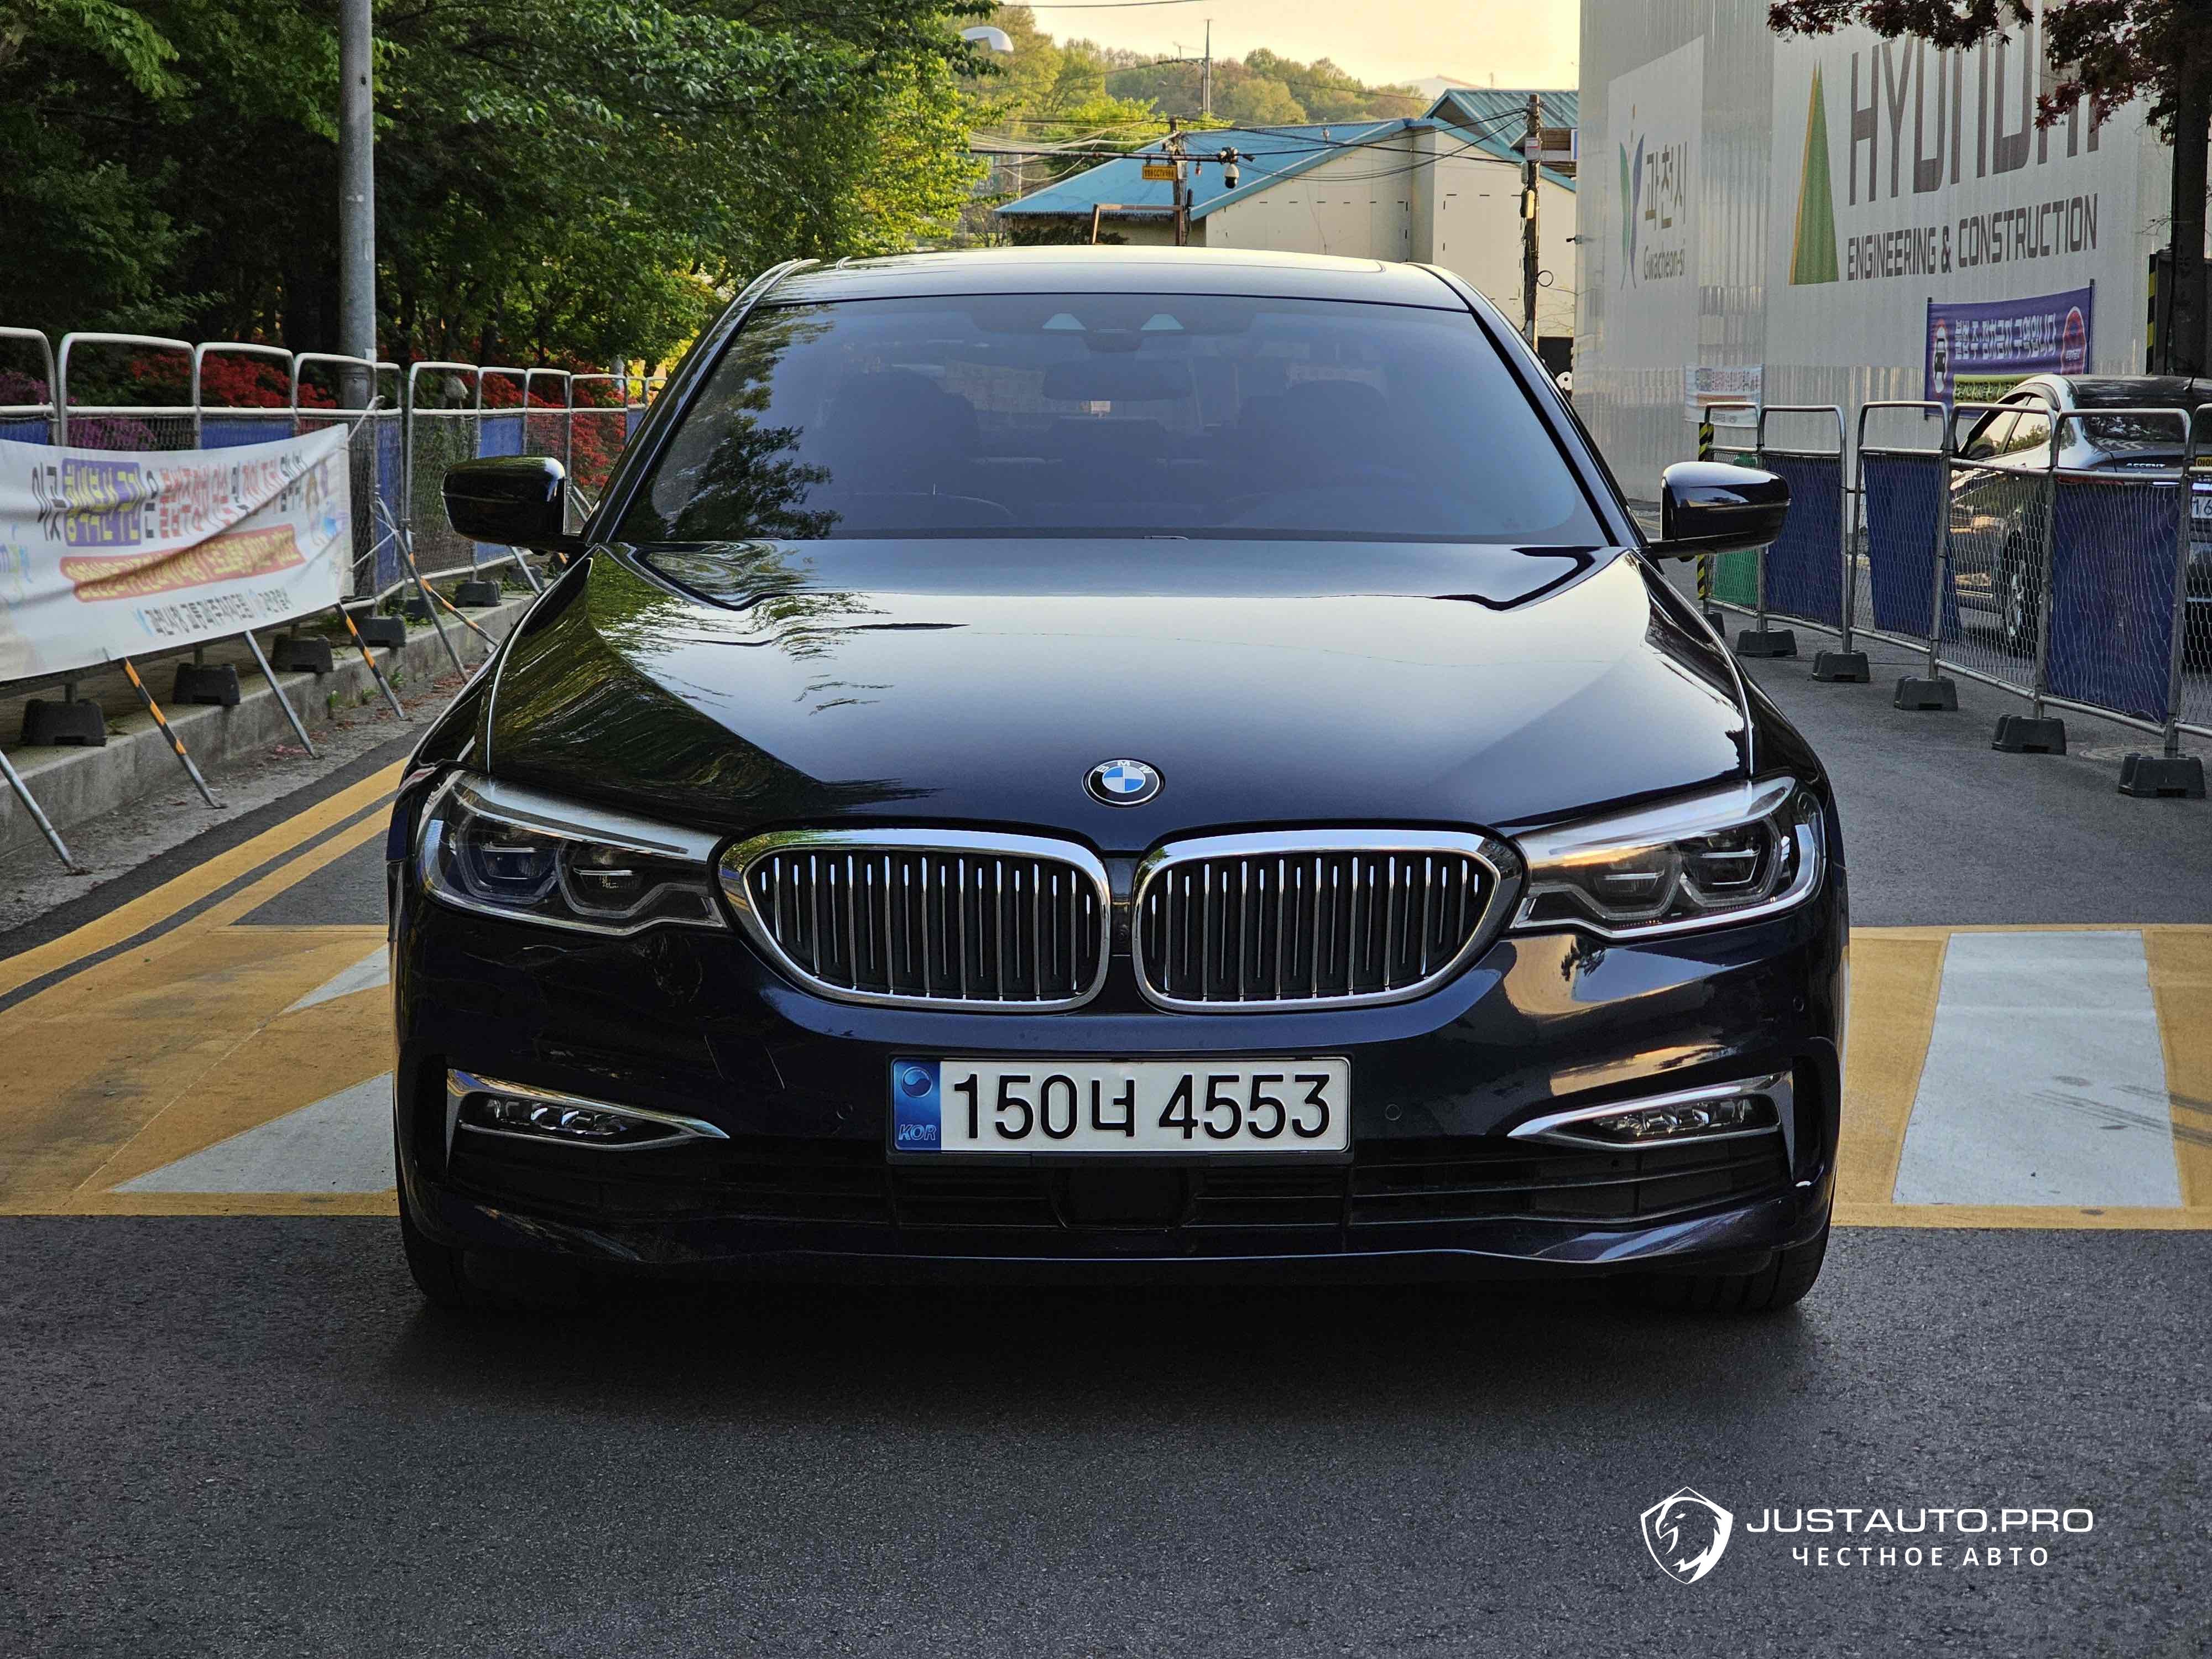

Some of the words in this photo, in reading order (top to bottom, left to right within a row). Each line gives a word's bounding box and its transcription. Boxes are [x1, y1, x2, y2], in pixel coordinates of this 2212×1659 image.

[1645, 141, 1687, 231] 과천시
[1644, 238, 1686, 280] Gwacheon-si
[1848, 227, 1936, 281] ENGINEERING
[1941, 225, 1952, 274] &
[1958, 192, 2098, 268] CONSTRUCTION
[898, 1123, 937, 1142] KOR
[953, 1073, 1135, 1140] 150너
[1159, 1073, 1331, 1140] 4553
